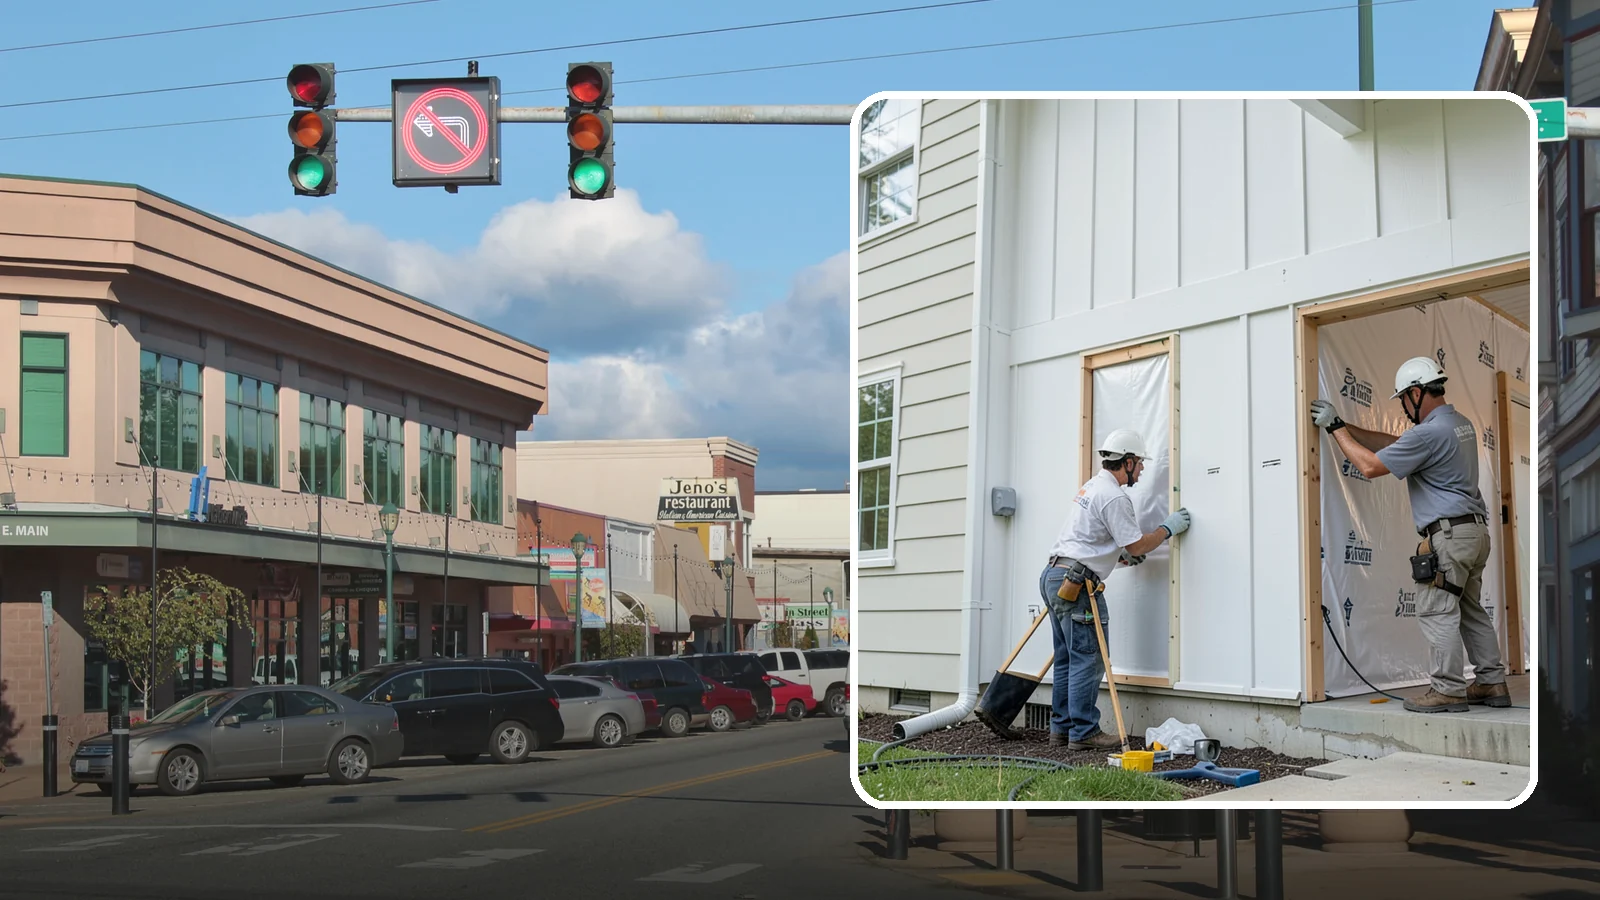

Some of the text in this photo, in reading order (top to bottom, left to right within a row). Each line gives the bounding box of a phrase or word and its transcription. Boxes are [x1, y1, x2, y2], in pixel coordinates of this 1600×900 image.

[669, 480, 728, 494] Jeno's
[665, 496, 731, 509] restaurant
[658, 510, 682, 520] Italian
[686, 510, 714, 519] American
[715, 509, 738, 519] Cuisine
[2, 525, 49, 536] E. MAIN
[786, 607, 828, 617] in Street
